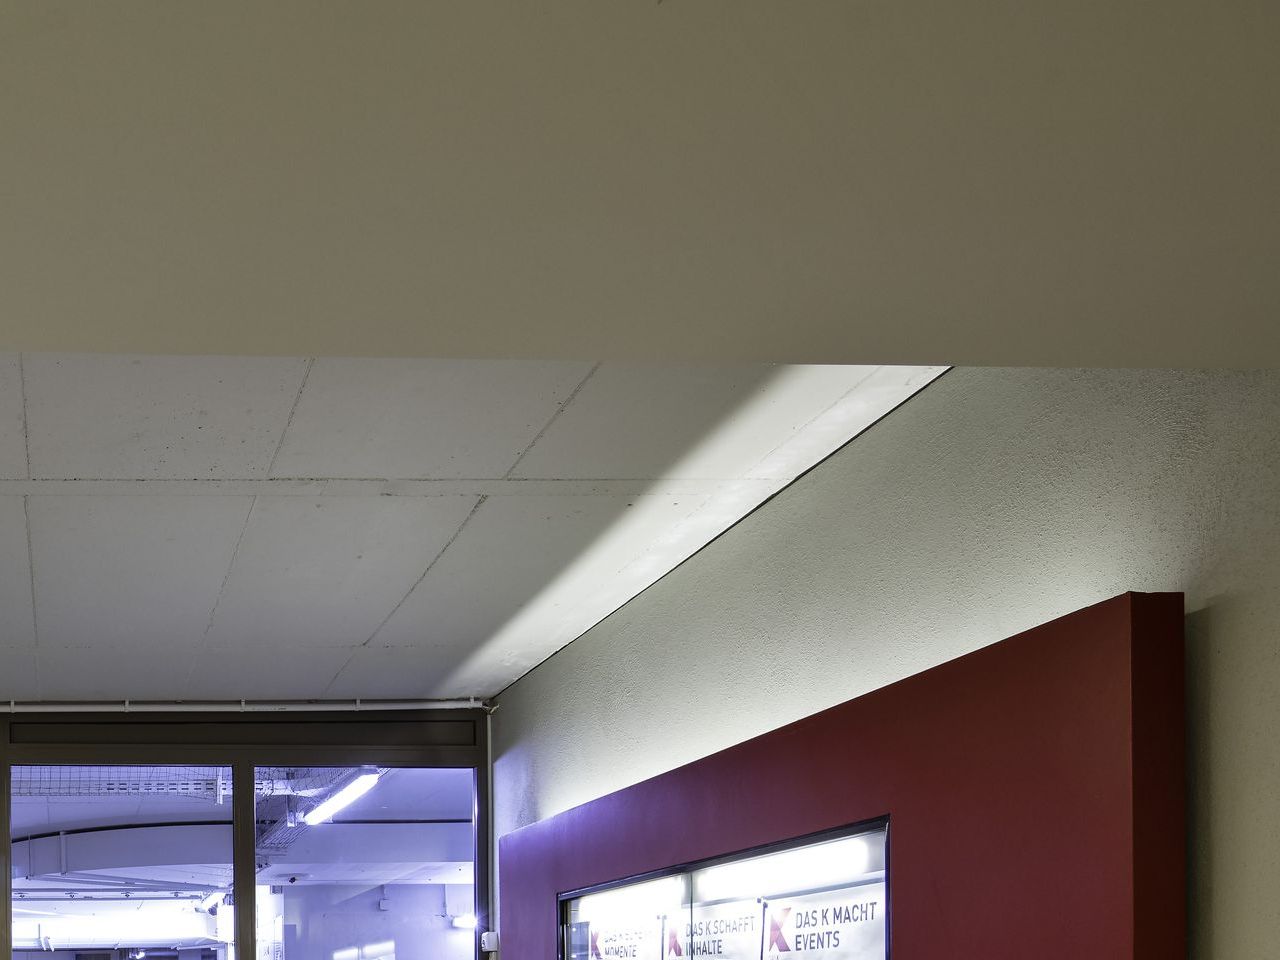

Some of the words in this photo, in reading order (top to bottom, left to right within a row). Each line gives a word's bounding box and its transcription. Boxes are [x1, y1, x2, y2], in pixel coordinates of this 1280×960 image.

[795, 910, 818, 928] DAS
[821, 908, 829, 926] K
[833, 901, 877, 925] MACHT
[685, 921, 703, 938] DAS
[705, 919, 712, 936] K
[713, 915, 755, 935] SCHAFFT
[685, 939, 723, 957] INHALTE
[795, 930, 840, 951] EVENTS
